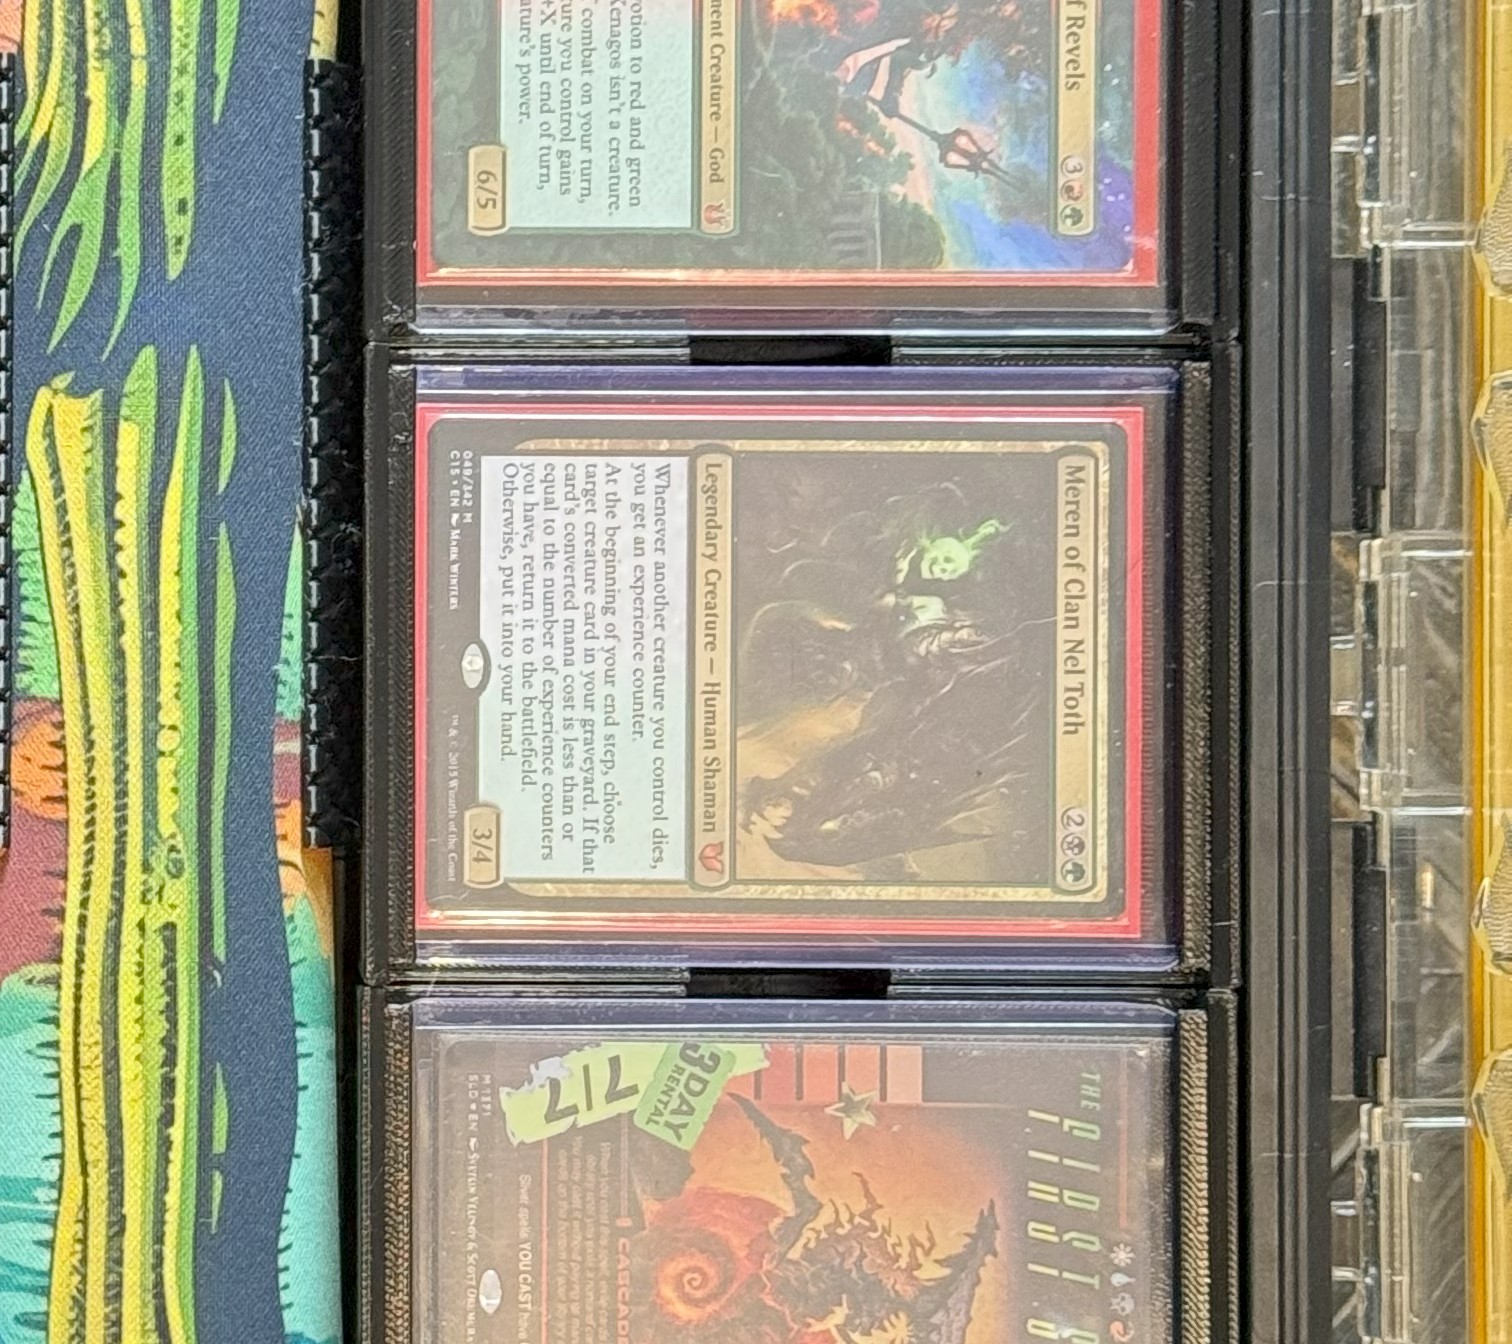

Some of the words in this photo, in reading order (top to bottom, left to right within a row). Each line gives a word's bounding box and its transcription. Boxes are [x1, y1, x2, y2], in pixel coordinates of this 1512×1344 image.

[630, 57, 642, 74] to
[1065, 16, 1086, 91] Revels
[630, 81, 645, 110] red
[709, 44, 725, 121] Creature
[629, 117, 645, 149] and
[626, 157, 640, 207] green
[709, 148, 724, 184] God
[476, 170, 497, 210] 6/5
[449, 451, 459, 475] C15
[463, 451, 472, 506] 049/342
[631, 463, 646, 495] you
[449, 490, 459, 507] EN
[463, 513, 472, 523] M
[631, 503, 646, 529] get
[654, 463, 671, 555] Whenever
[702, 463, 722, 561] Legendary
[1064, 465, 1085, 540] Meren
[633, 537, 645, 557] an
[1064, 547, 1085, 570] of
[630, 565, 649, 662] experience
[654, 561, 670, 631] another
[704, 569, 721, 652] Creature
[1064, 578, 1084, 629] Clan
[653, 637, 668, 711] creature
[1064, 639, 1084, 675] Nel
[632, 668, 644, 742] counter.
[701, 682, 720, 750] Human
[1062, 682, 1084, 736] Toth
[650, 717, 664, 749] you
[653, 757, 668, 820] control
[703, 756, 720, 832] Shaman
[473, 828, 492, 864] 3/4
[650, 828, 668, 869] dies,
[679, 1043, 721, 1074] 3
[645, 1064, 686, 1125] RENTAL
[664, 1073, 709, 1142] DAY
[1080, 1073, 1101, 1110] THE
[1028, 1110, 1100, 1289] FIRST
[519, 1242, 531, 1271] YOU
[519, 1274, 531, 1310] CAST
